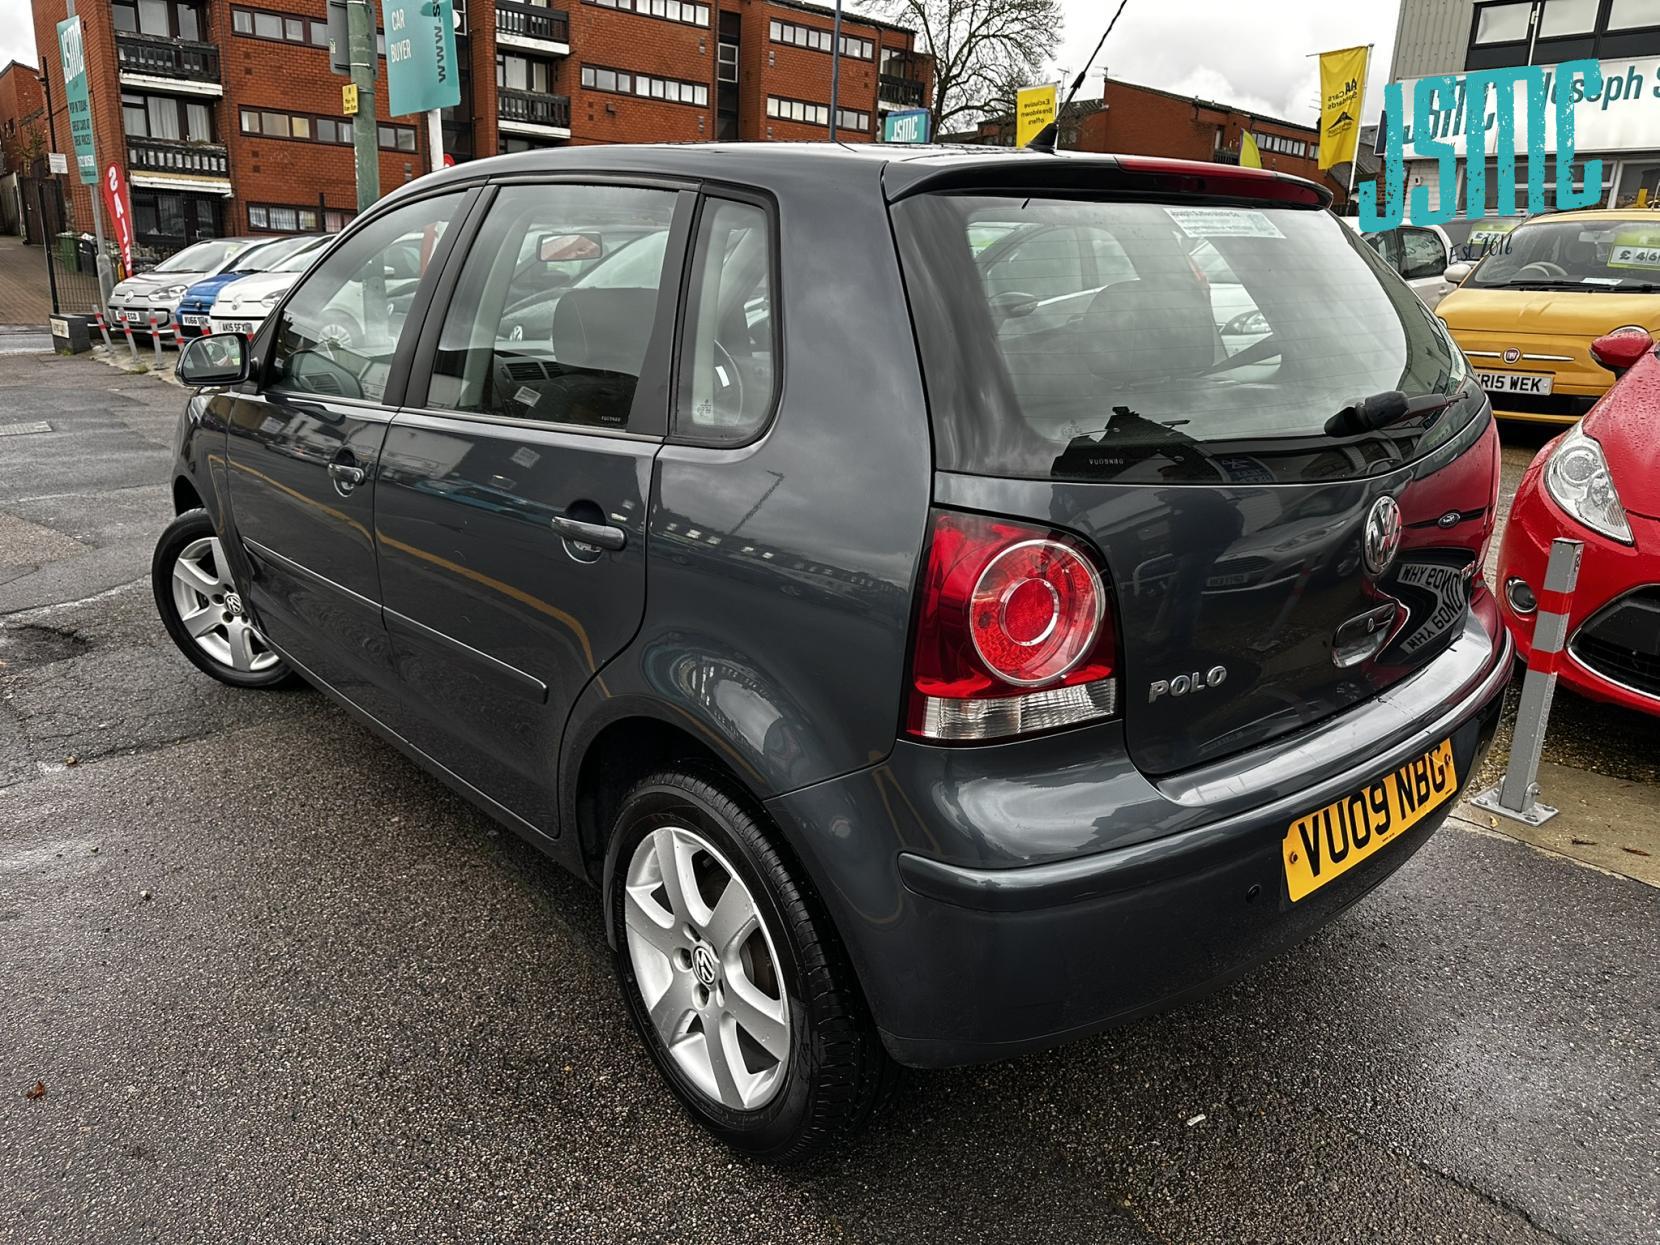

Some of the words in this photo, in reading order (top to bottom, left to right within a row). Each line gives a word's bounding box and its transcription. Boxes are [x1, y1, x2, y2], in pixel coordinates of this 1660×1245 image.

[391, 9, 406, 31] CAR
[390, 39, 412, 63] BUYER
[1544, 65, 1644, 111] Jsph
[891, 115, 918, 142] JSMC
[1618, 249, 1660, 262] £46
[1478, 374, 1505, 389] R15
[1509, 376, 1542, 392] WEK
[1148, 665, 1227, 704] POLO
[1297, 782, 1392, 878] VU09
[1394, 744, 1447, 821] NBG
